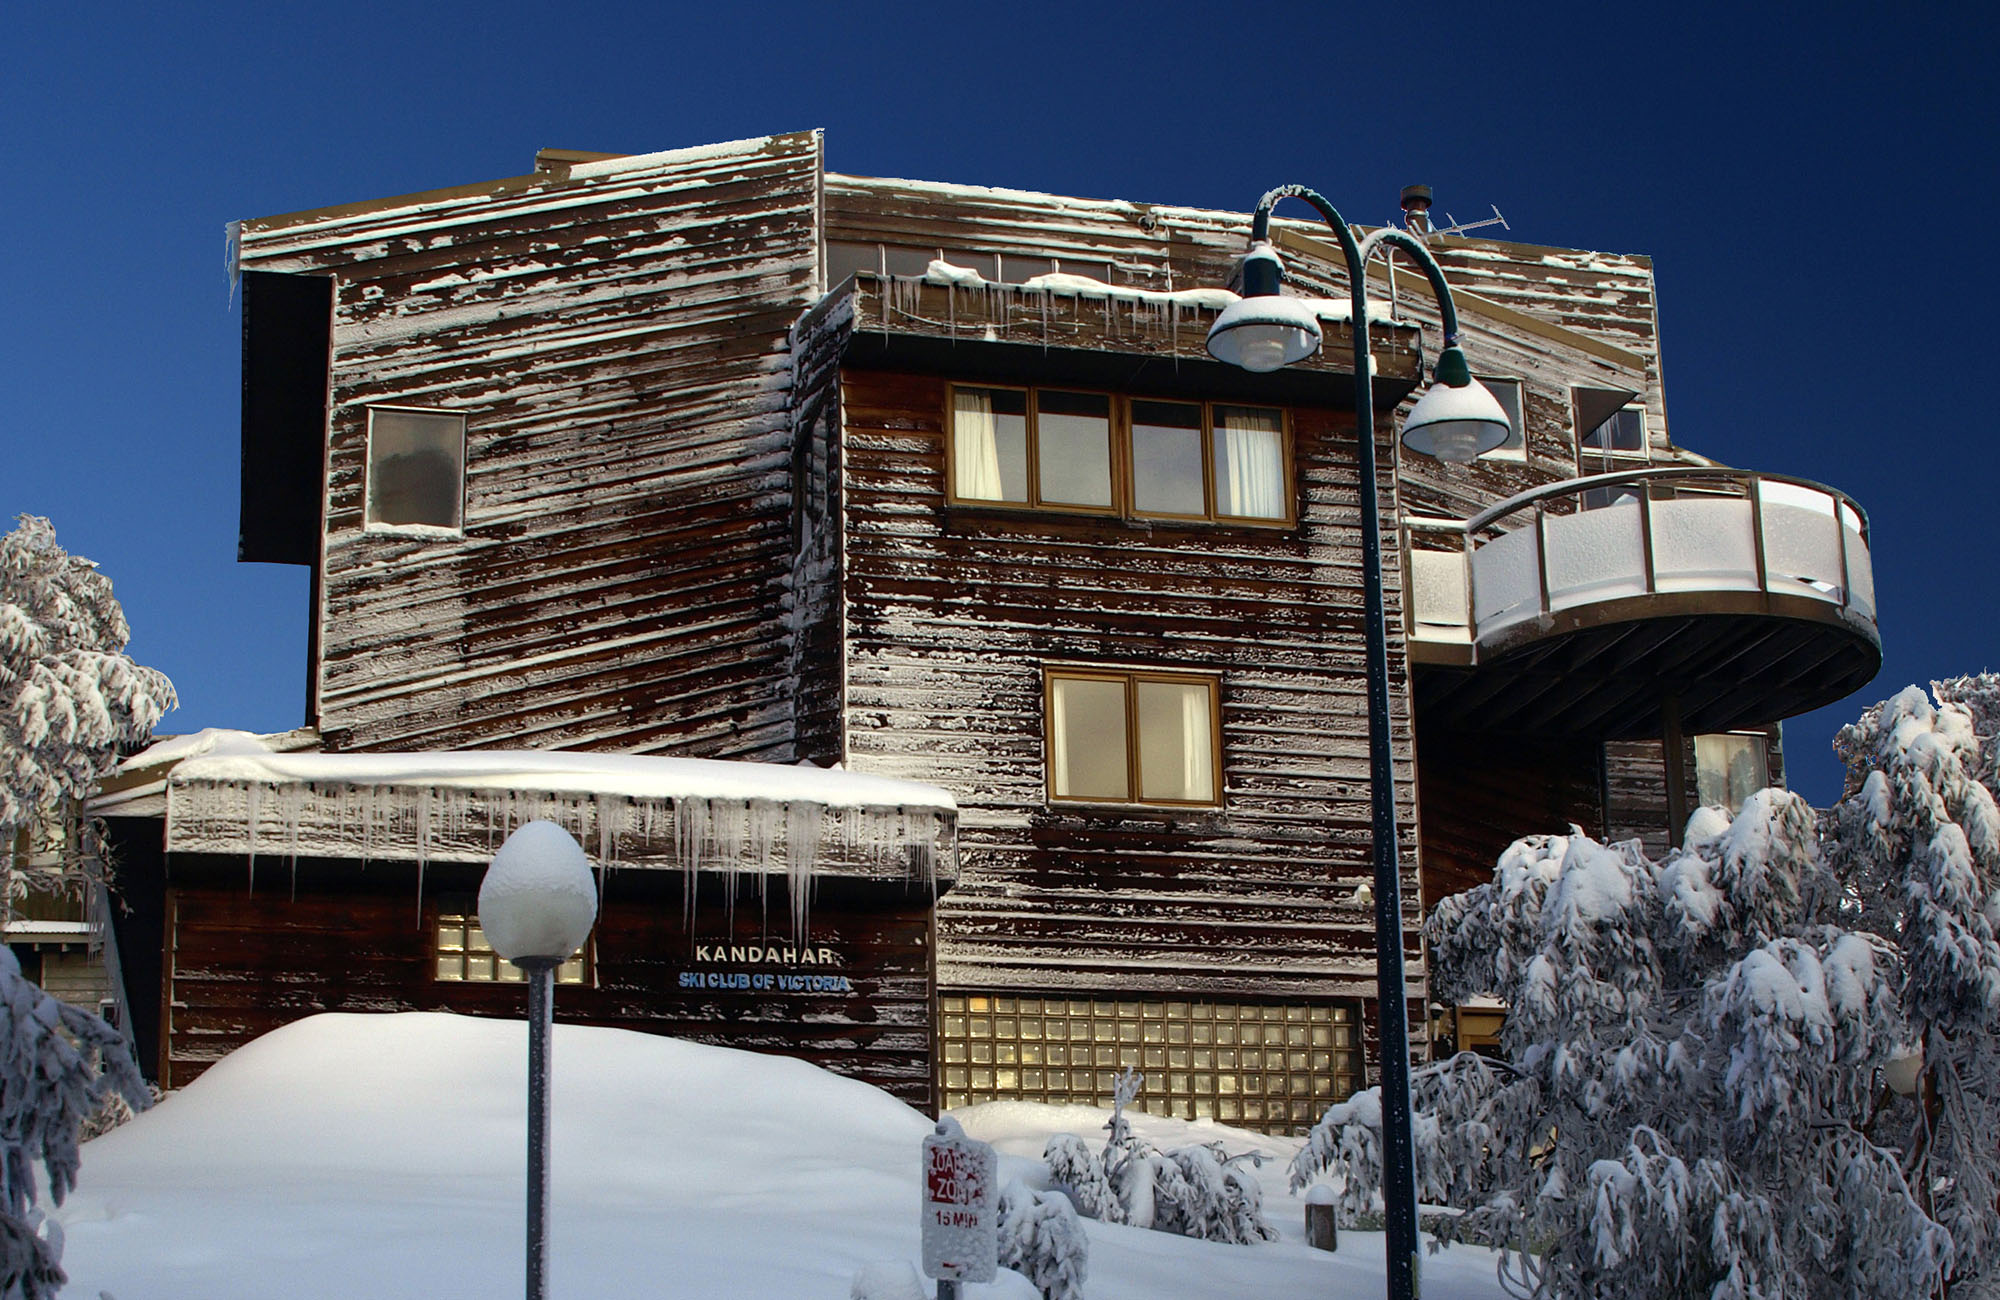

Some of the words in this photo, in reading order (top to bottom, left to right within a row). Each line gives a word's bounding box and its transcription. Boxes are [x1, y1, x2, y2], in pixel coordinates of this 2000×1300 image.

[696, 945, 833, 964] KANDAHAR
[678, 973, 706, 988] SKI
[708, 974, 751, 989] CLUB
[752, 975, 775, 989] OF
[777, 976, 850, 991] VICTORIA
[936, 1210, 951, 1226] 15
